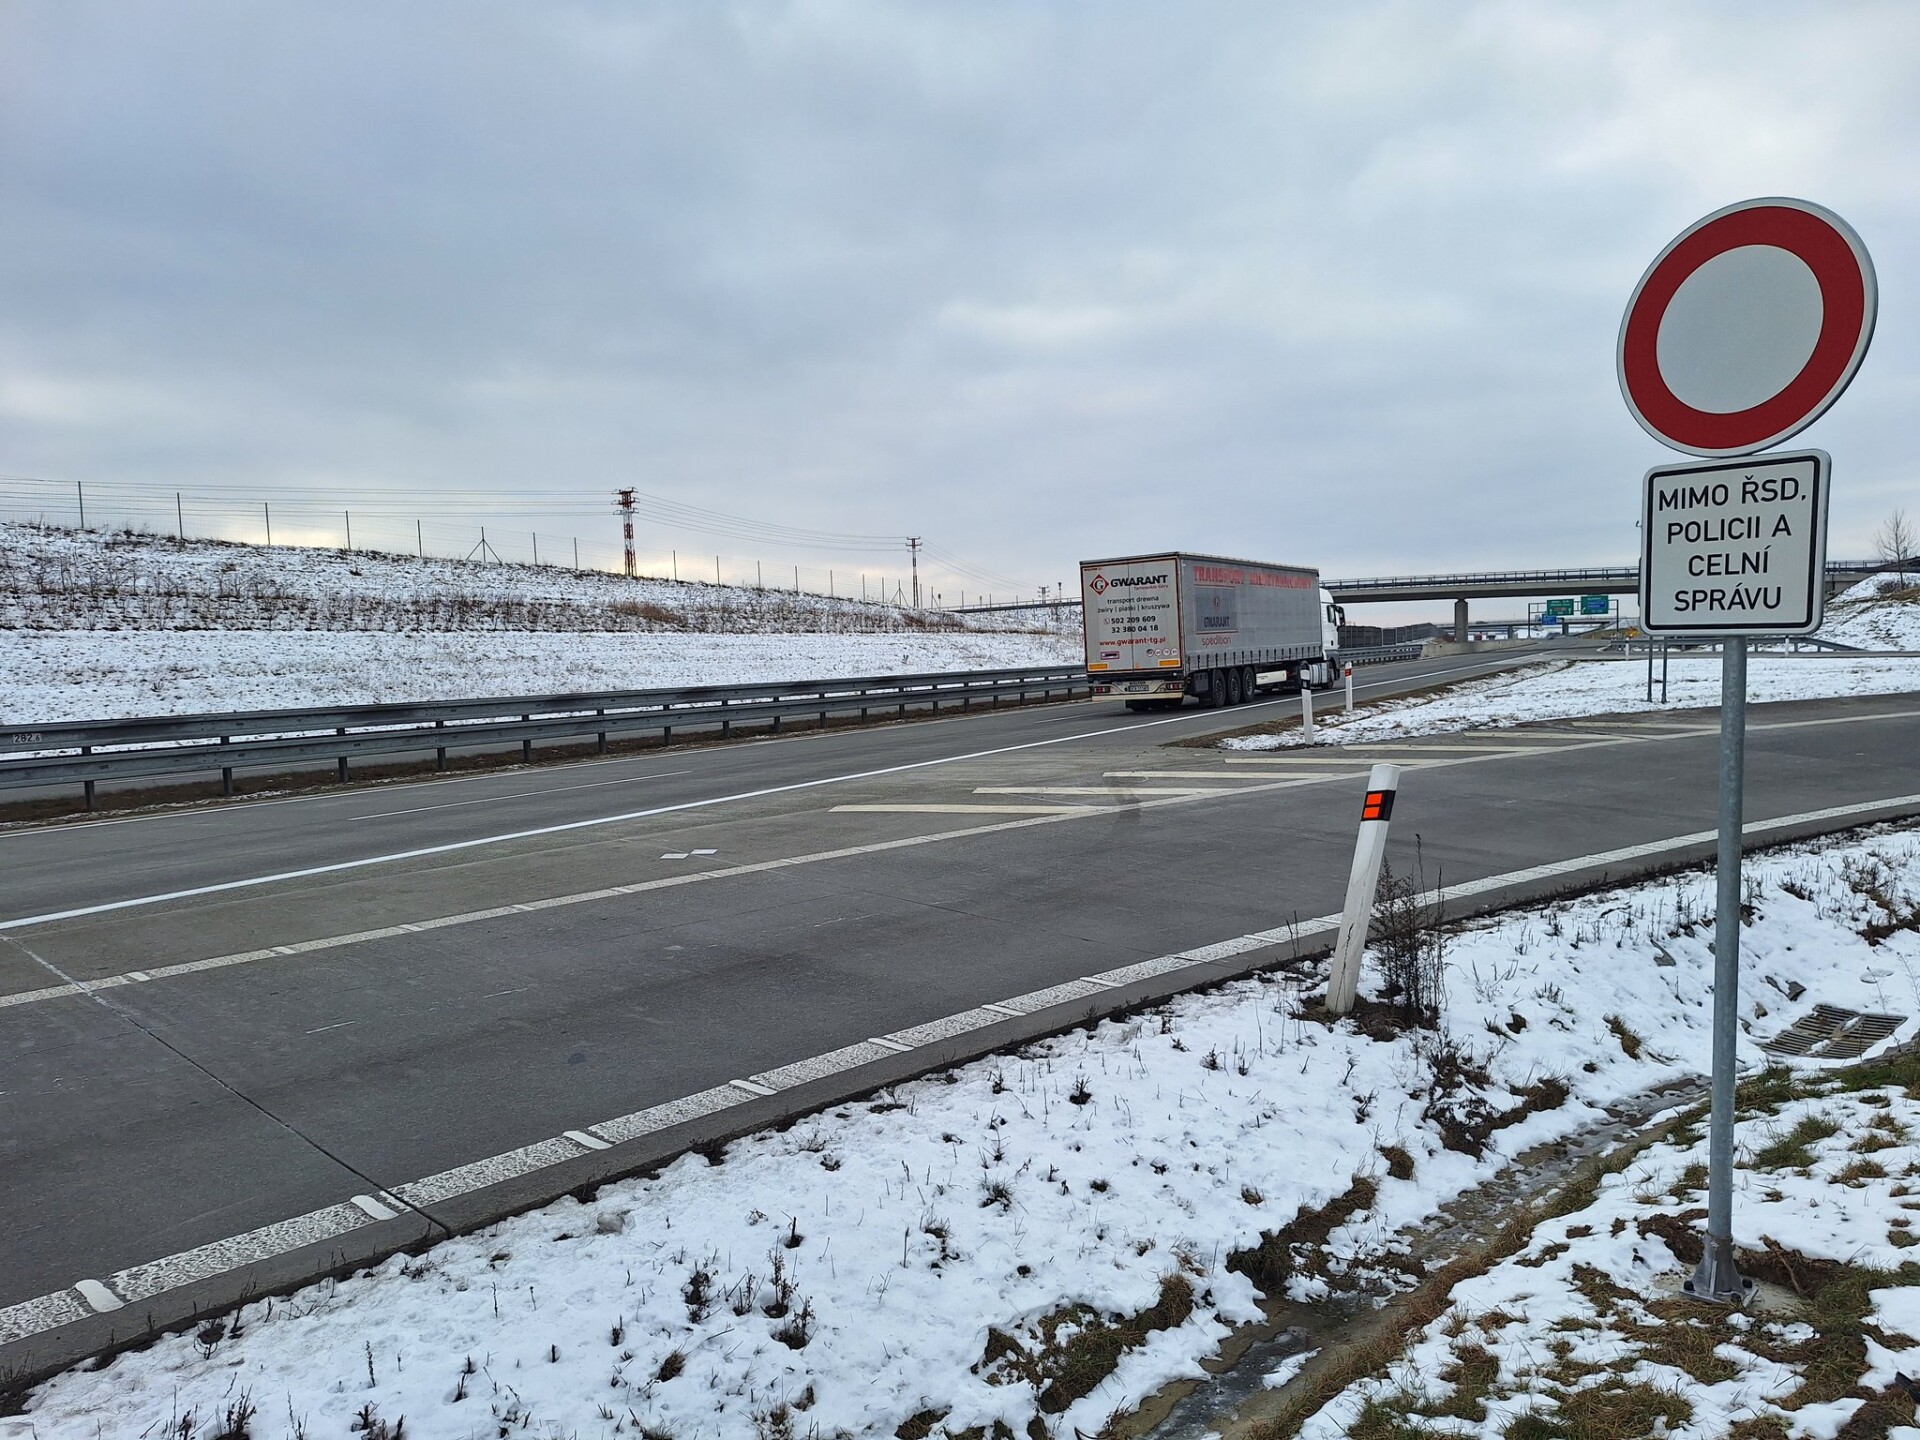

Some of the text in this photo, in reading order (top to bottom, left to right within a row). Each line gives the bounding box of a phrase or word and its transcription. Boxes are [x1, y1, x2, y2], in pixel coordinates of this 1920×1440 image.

[1658, 475, 1806, 511] MIMO ŘSD,
[1667, 514, 1792, 544] POLICII A
[1688, 545, 1772, 577] CELNÍ
[1110, 574, 1168, 588] GWARANT
[1107, 597, 1135, 605] transport
[1673, 582, 1782, 611] SPRÁVU
[1141, 603, 1170, 611] kruszywa
[1111, 626, 1120, 634] 32
[1123, 625, 1136, 633] 380
[1099, 636, 1166, 646] www.gwarant-tg.pl
[14, 733, 41, 743] 282.6
